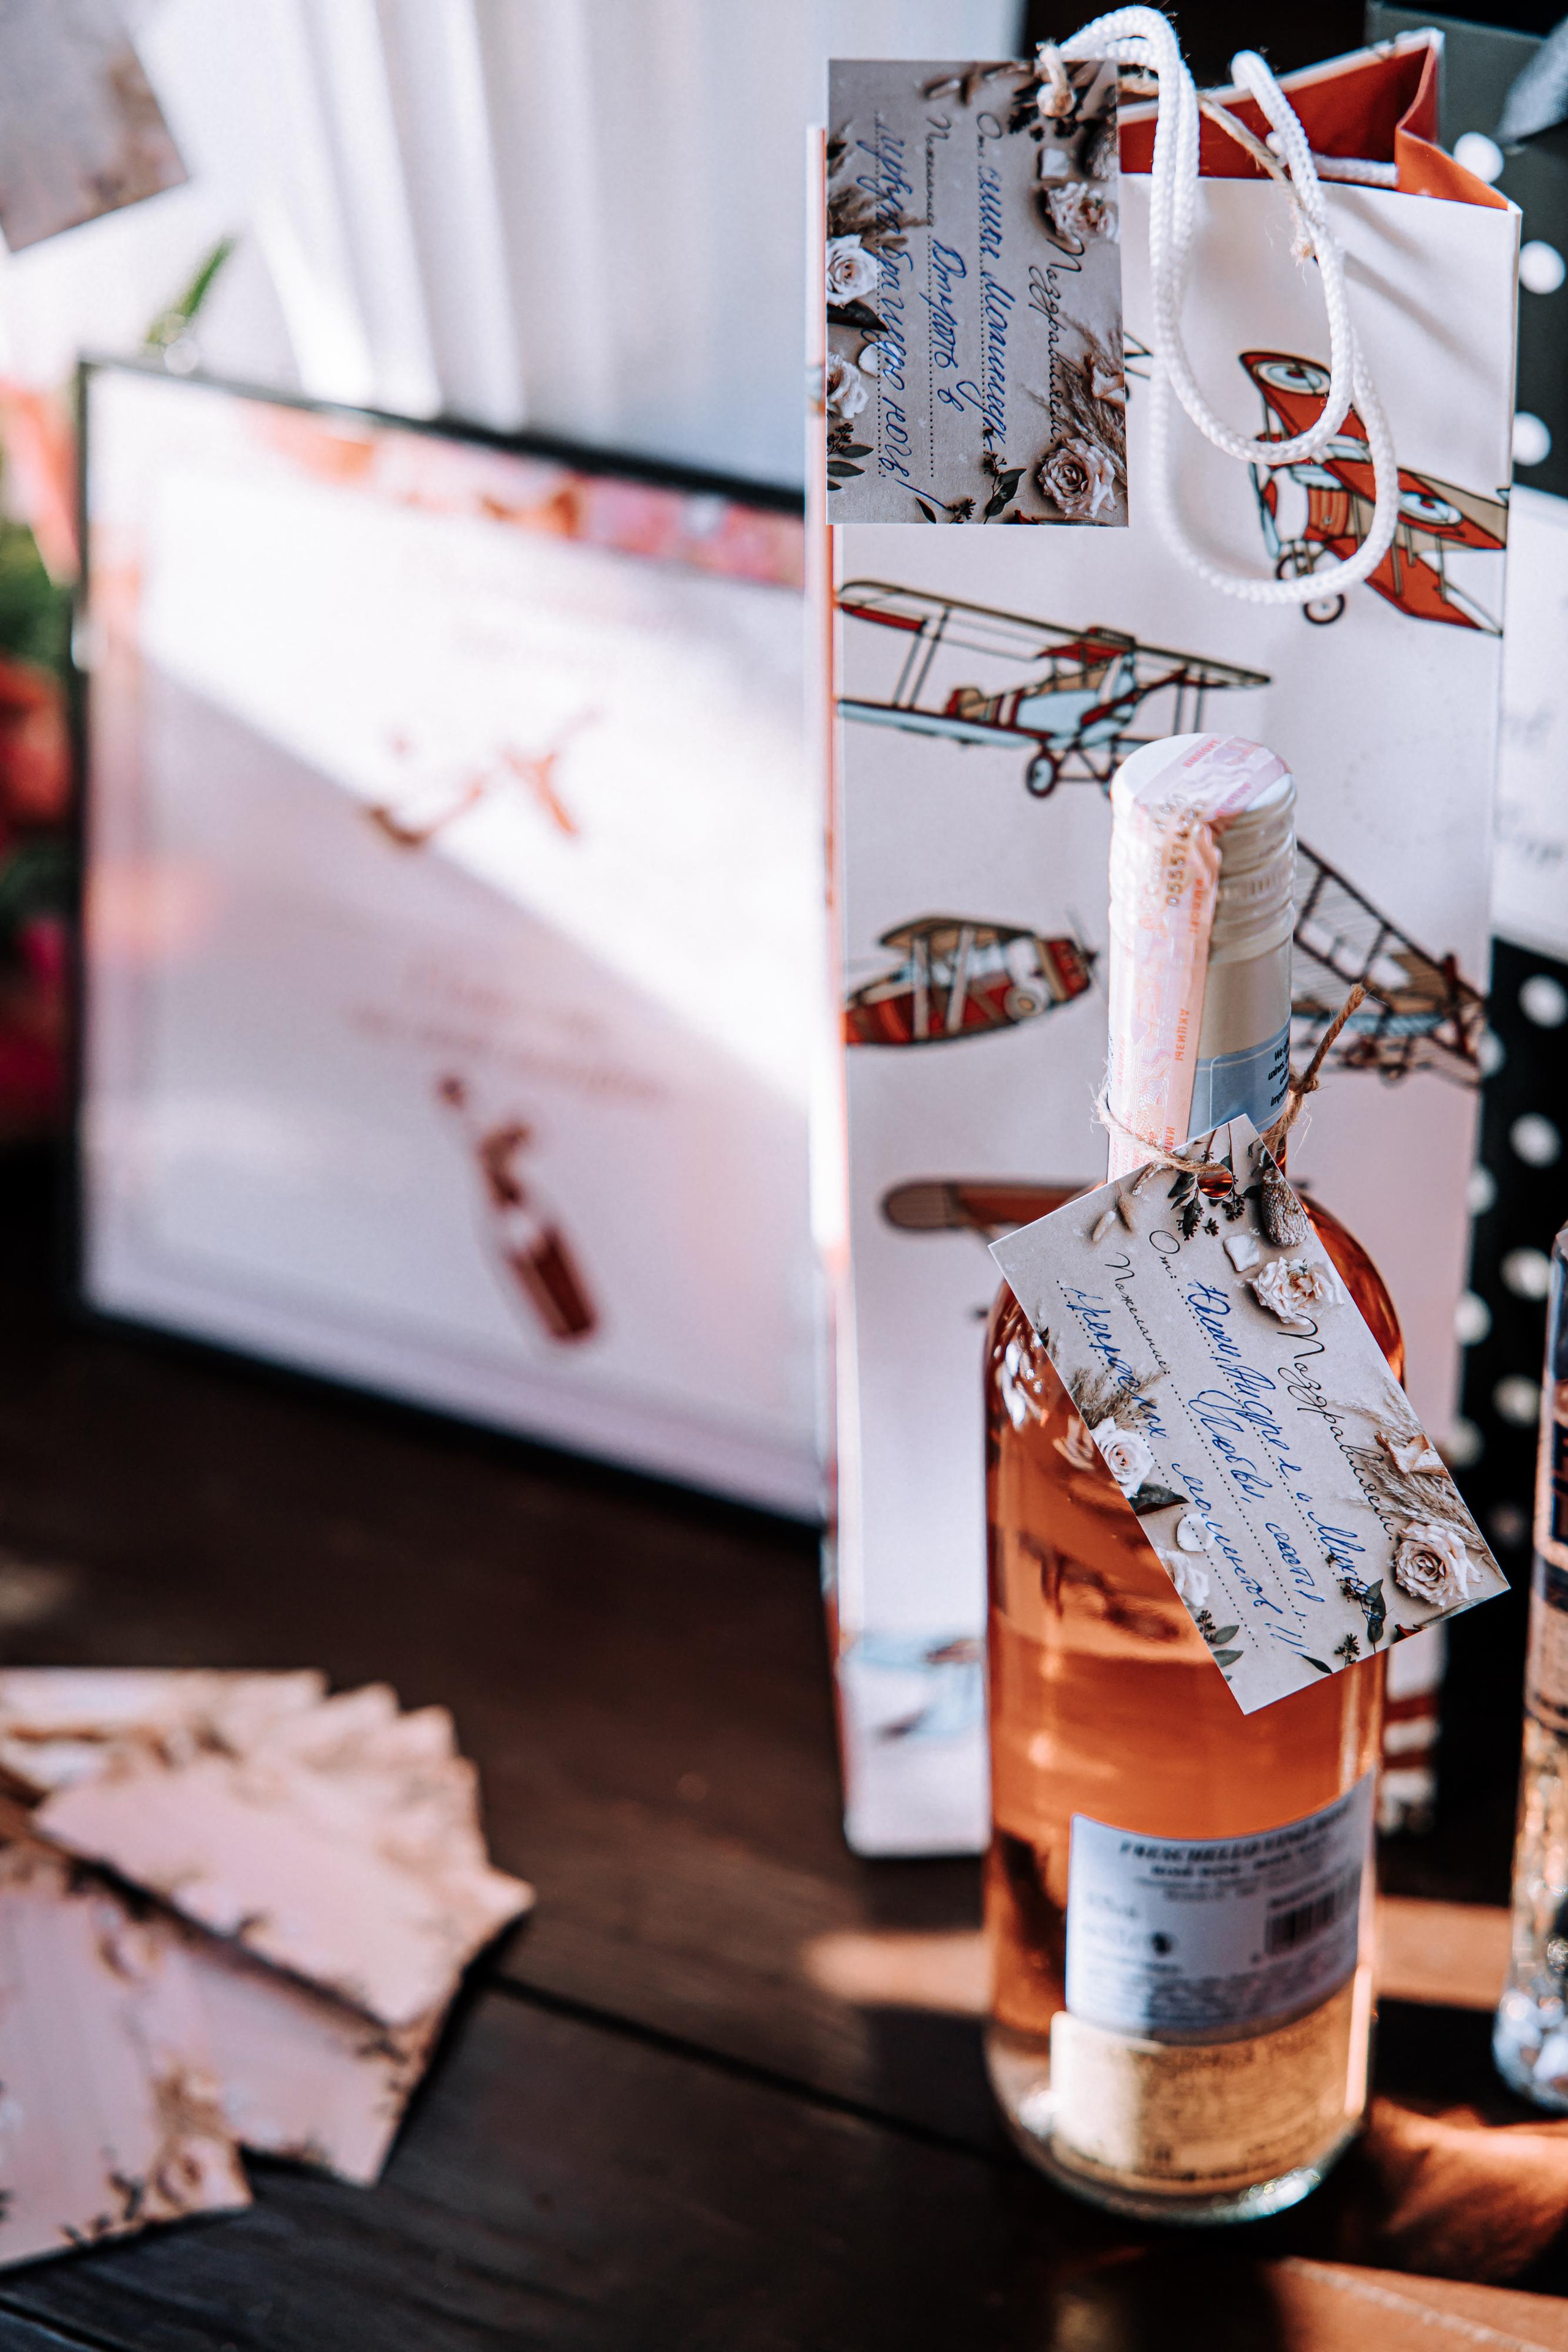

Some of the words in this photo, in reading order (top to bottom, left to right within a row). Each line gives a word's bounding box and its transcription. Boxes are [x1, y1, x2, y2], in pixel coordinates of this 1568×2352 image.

[1175, 1008, 1189, 1061] АКЦИЗЫ
[1148, 1230, 1180, 1278] От:
[1104, 1254, 1170, 1374] Пожелание:
